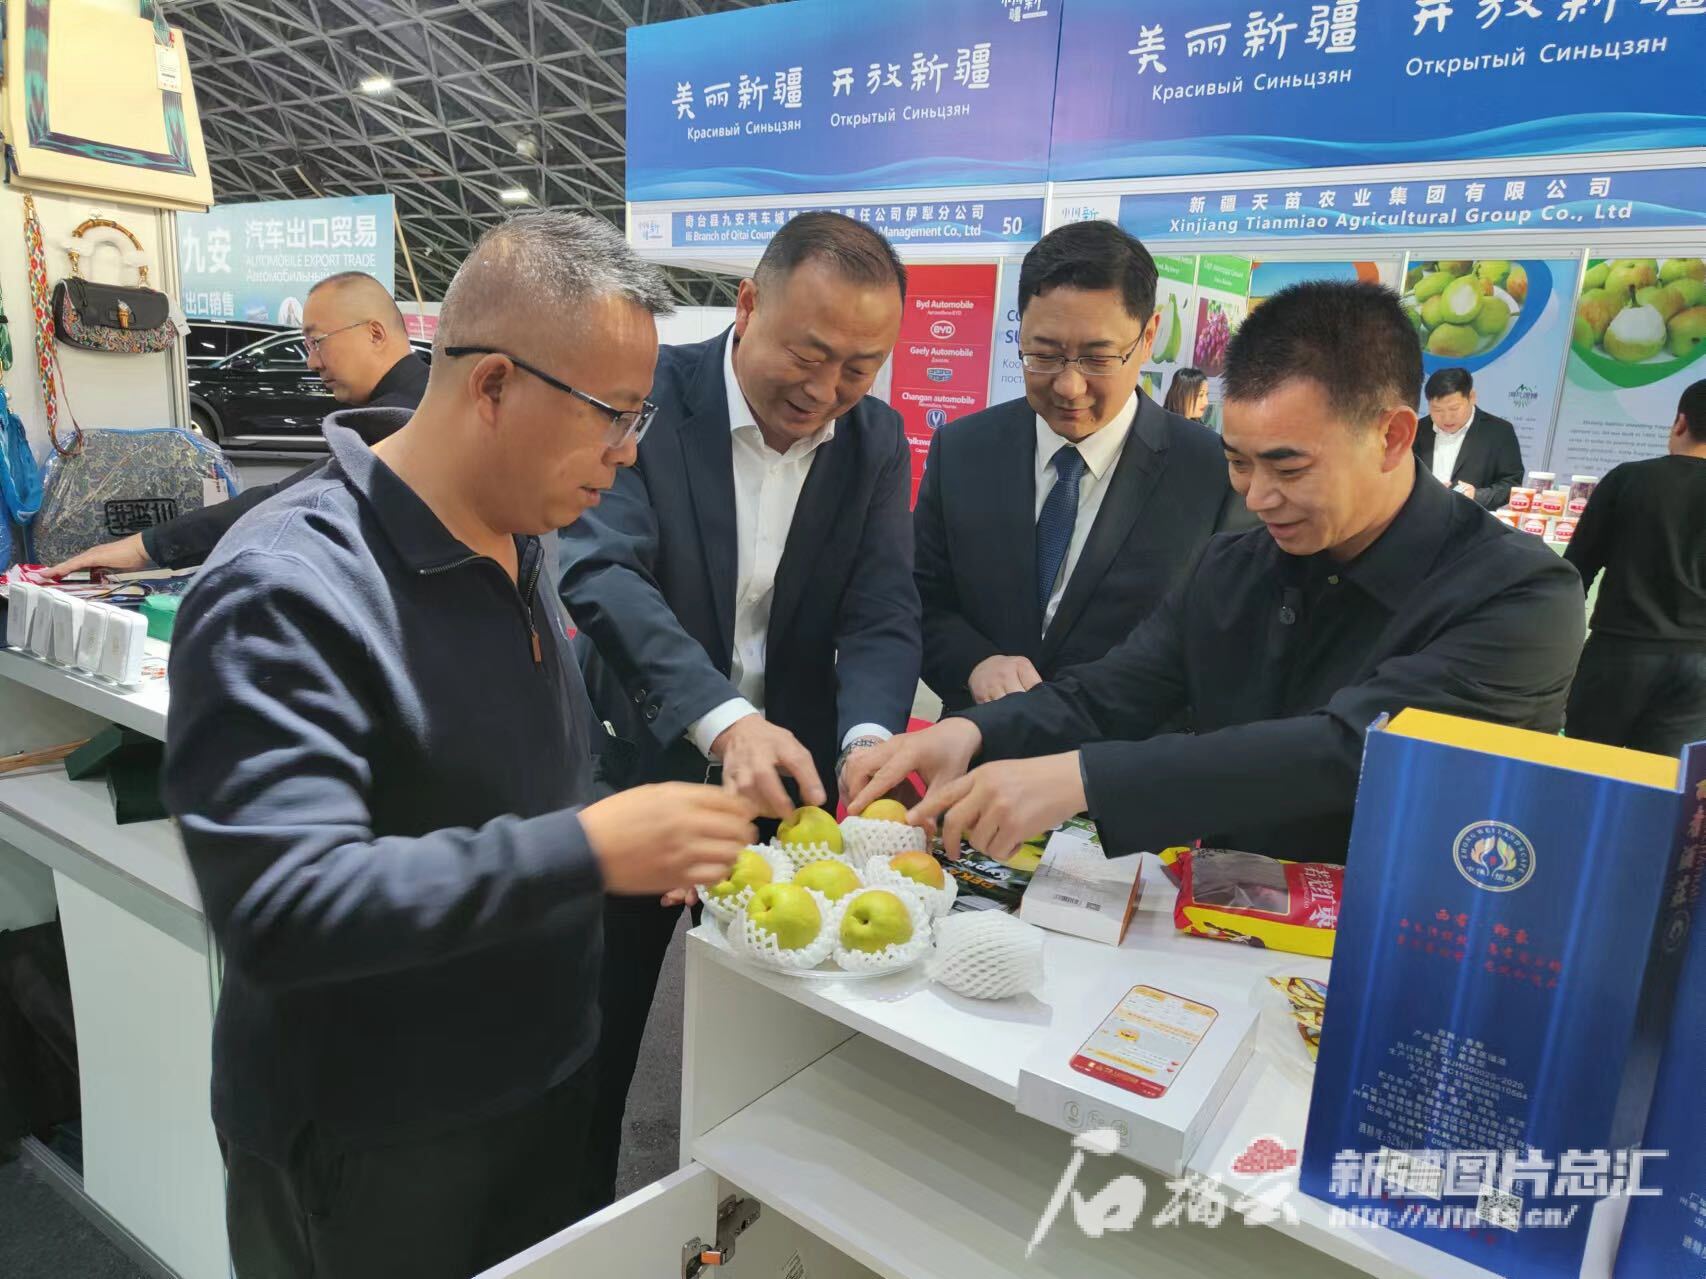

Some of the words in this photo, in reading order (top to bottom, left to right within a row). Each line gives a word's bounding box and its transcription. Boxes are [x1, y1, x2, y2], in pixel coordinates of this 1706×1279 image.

[1128, 0, 1361, 74] 美丽新疆
[672, 66, 802, 119] 美丽新疆
[832, 43, 991, 97] 开放新疆
[1152, 76, 1243, 104] Красивый
[1253, 69, 1352, 91] Синьцзян
[1405, 46, 1526, 77] Открытый
[1539, 37, 1668, 63] Синьцзян
[687, 122, 740, 142] Красивый
[745, 119, 801, 135] Синьцзян
[830, 107, 896, 128] Открытый
[902, 104, 970, 120] Синьцзян
[1189, 177, 1611, 214] 新疆天苗农业集团有限公司
[245, 215, 378, 250] 汽车出口贸易
[694, 230, 720, 242] Branch
[722, 229, 730, 242] of
[731, 229, 749, 242] Qitai
[878, 224, 942, 241] Management
[964, 223, 982, 238] Ltd
[1002, 216, 1023, 235] 50
[1169, 218, 1238, 235] Xinjiang
[1246, 215, 1327, 231] Tianmiao
[1335, 208, 1456, 231] Agricultural
[1465, 207, 1532, 224] Group
[1541, 205, 1583, 222] Co.,
[1595, 202, 1633, 220] Ltd
[183, 226, 233, 274] 九安
[246, 254, 302, 268] AUTOMOBILE
[304, 254, 340, 268] EXPORT
[343, 253, 377, 267] TRADE
[185, 290, 234, 317] 出口销售
[916, 300, 930, 310] Byd
[931, 300, 974, 309] Automobile
[931, 347, 973, 357] Automobile
[902, 392, 932, 404] Changan
[933, 395, 975, 405] automobile
